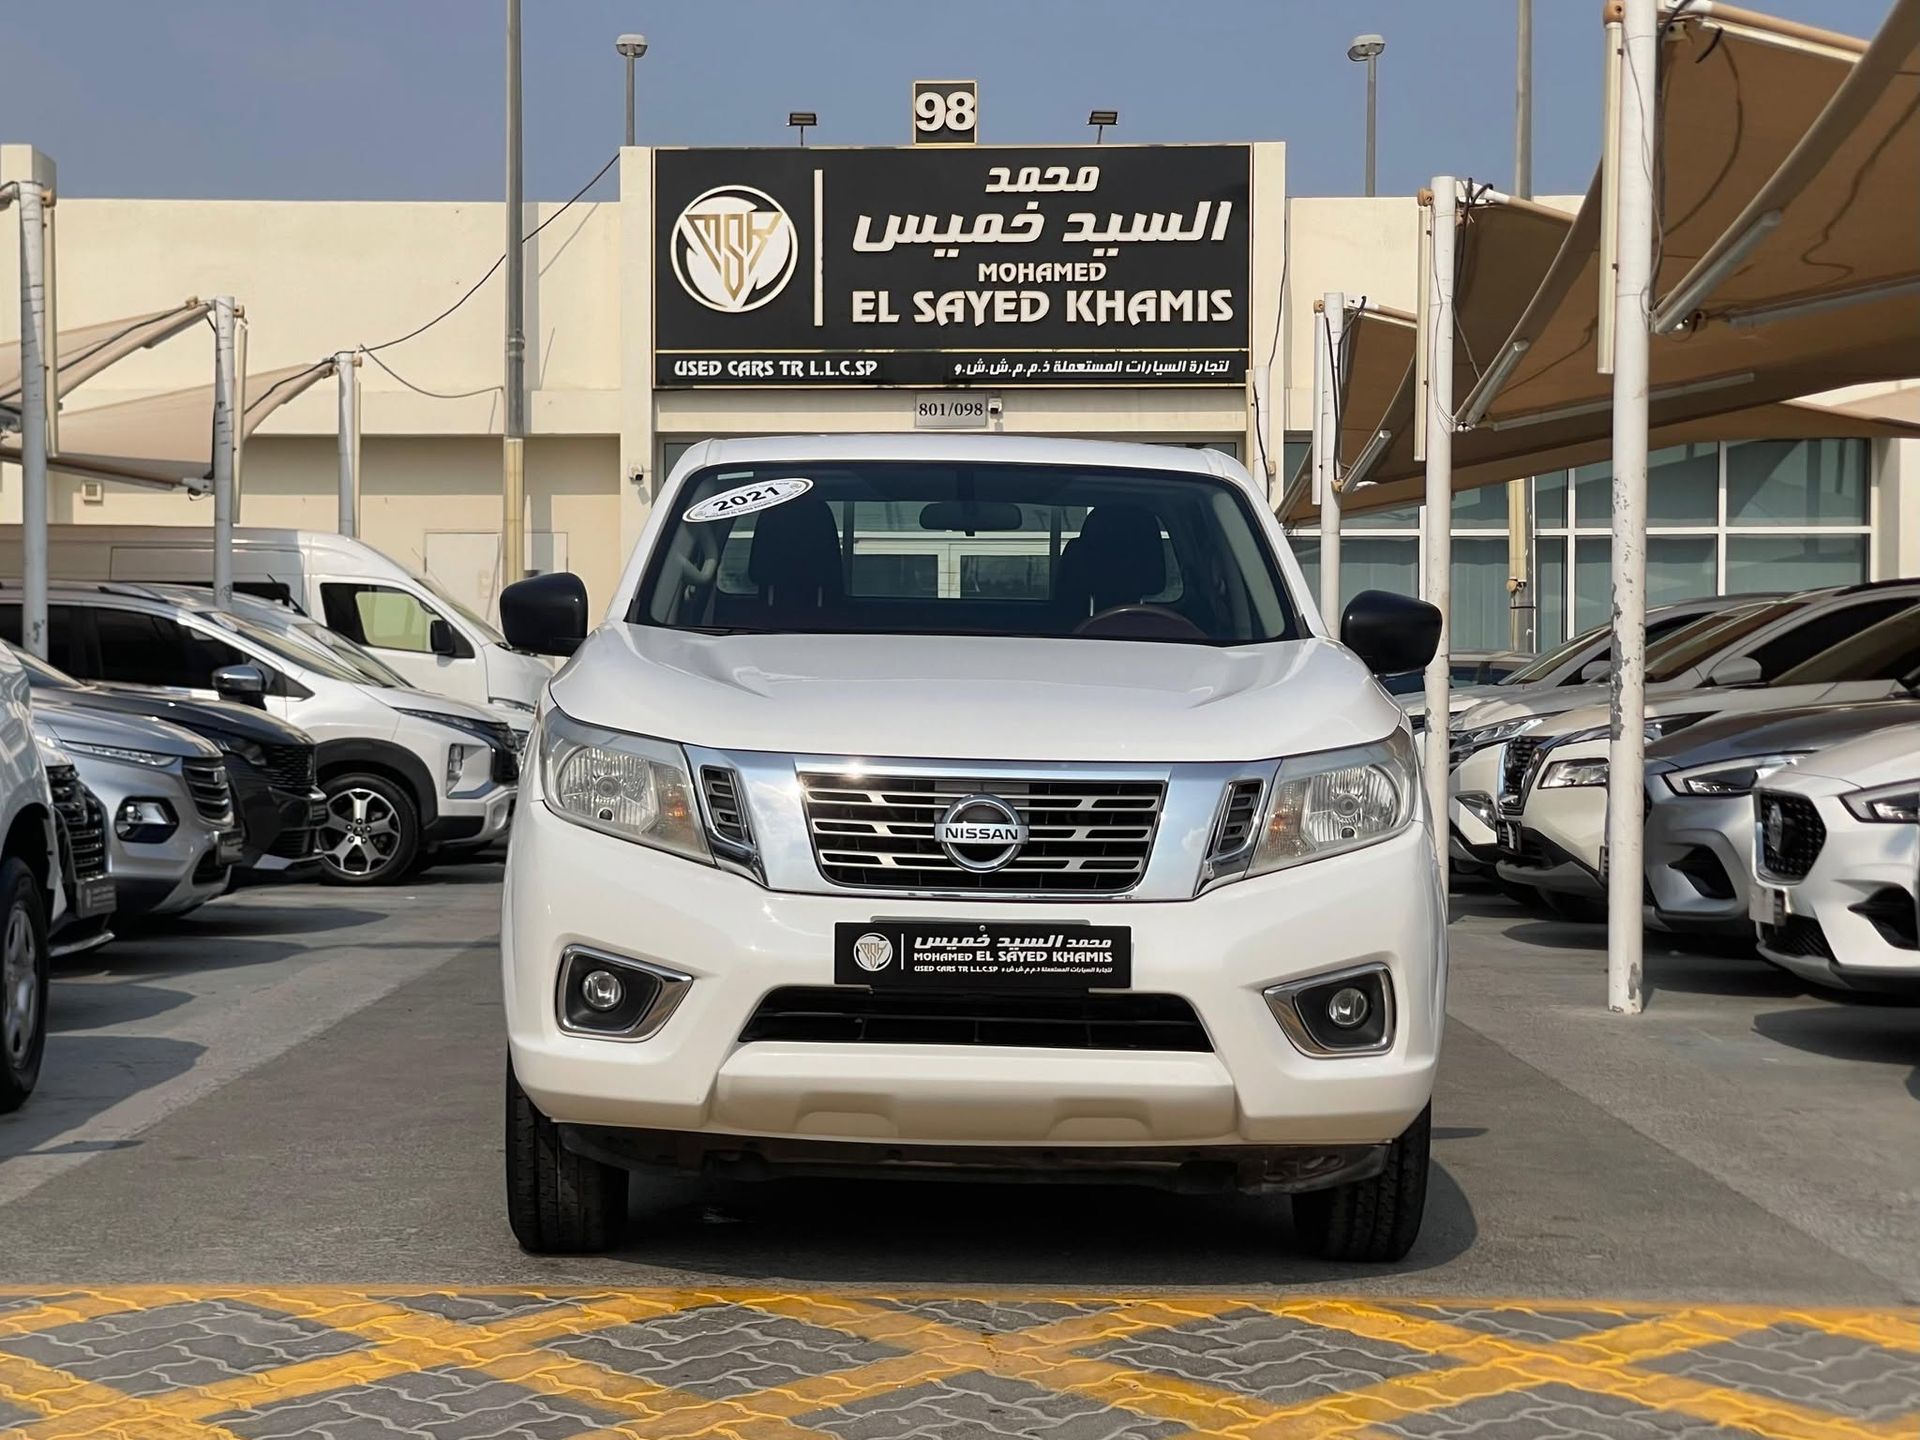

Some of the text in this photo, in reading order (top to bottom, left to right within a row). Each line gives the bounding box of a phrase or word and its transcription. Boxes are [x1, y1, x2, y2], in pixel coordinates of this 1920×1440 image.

[915, 92, 977, 131] 98
[985, 166, 1100, 193] محمد
[852, 200, 1233, 258] السيد خميس
[978, 262, 1107, 284] MOHAMED
[852, 289, 1234, 327] EL SAYED KHAMIS
[673, 360, 878, 378] USED CARS TR L.L.C.SP
[1053, 360, 1123, 373] المستعملة
[1125, 360, 1187, 376] السيارات
[1188, 360, 1230, 376] لتجارة
[919, 402, 983, 417] 801/098
[712, 486, 781, 512] 2021
[945, 827, 1018, 840] NISSAN
[914, 934, 1112, 951] محمد السيد خميس
[913, 950, 1113, 963] MOHAMED EL SAYED KHAMIS
[936, 965, 956, 973] CARS
[957, 965, 969, 973] TR
